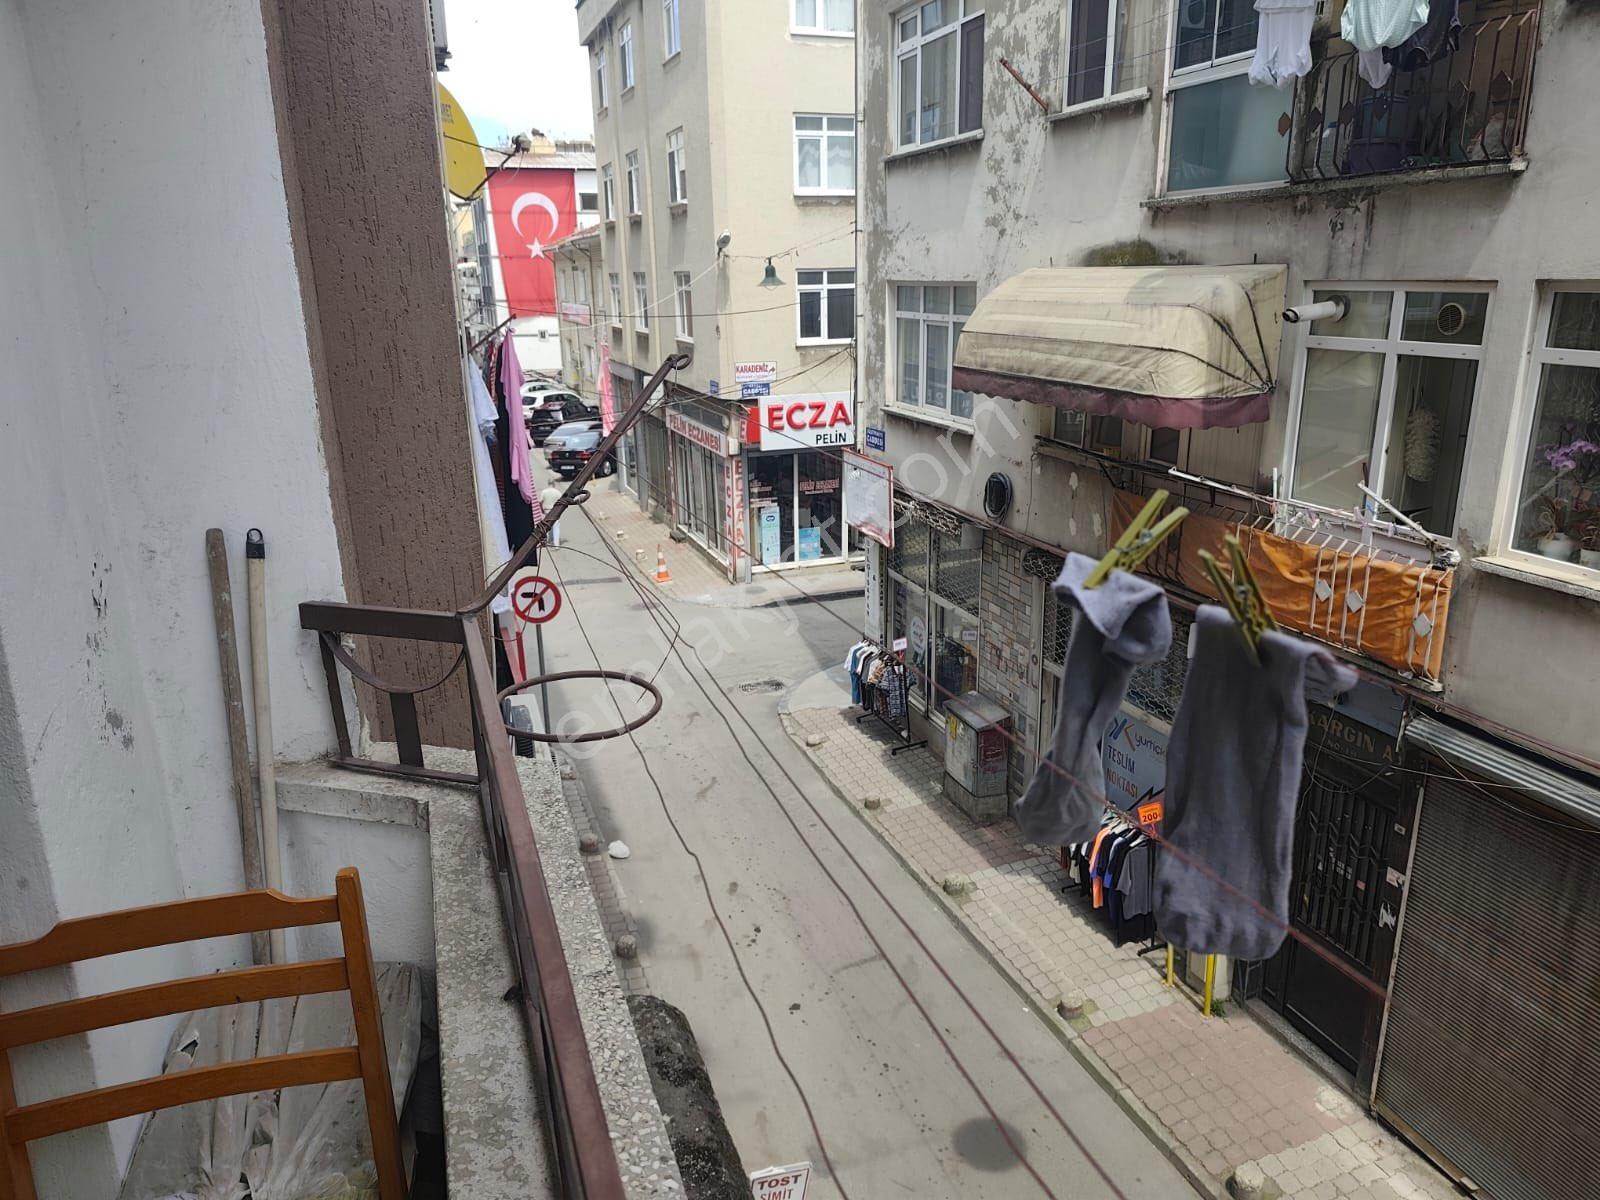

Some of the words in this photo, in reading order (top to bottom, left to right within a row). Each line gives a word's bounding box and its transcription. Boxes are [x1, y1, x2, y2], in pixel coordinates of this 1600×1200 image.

[736, 362, 769, 373] KARADENİZ
[767, 400, 852, 432] ECZA
[815, 430, 847, 445] PELİN
[1108, 744, 1135, 775] TESLİM
[1106, 767, 1138, 799] NOKTASI
[758, 1174, 802, 1191] TOST
